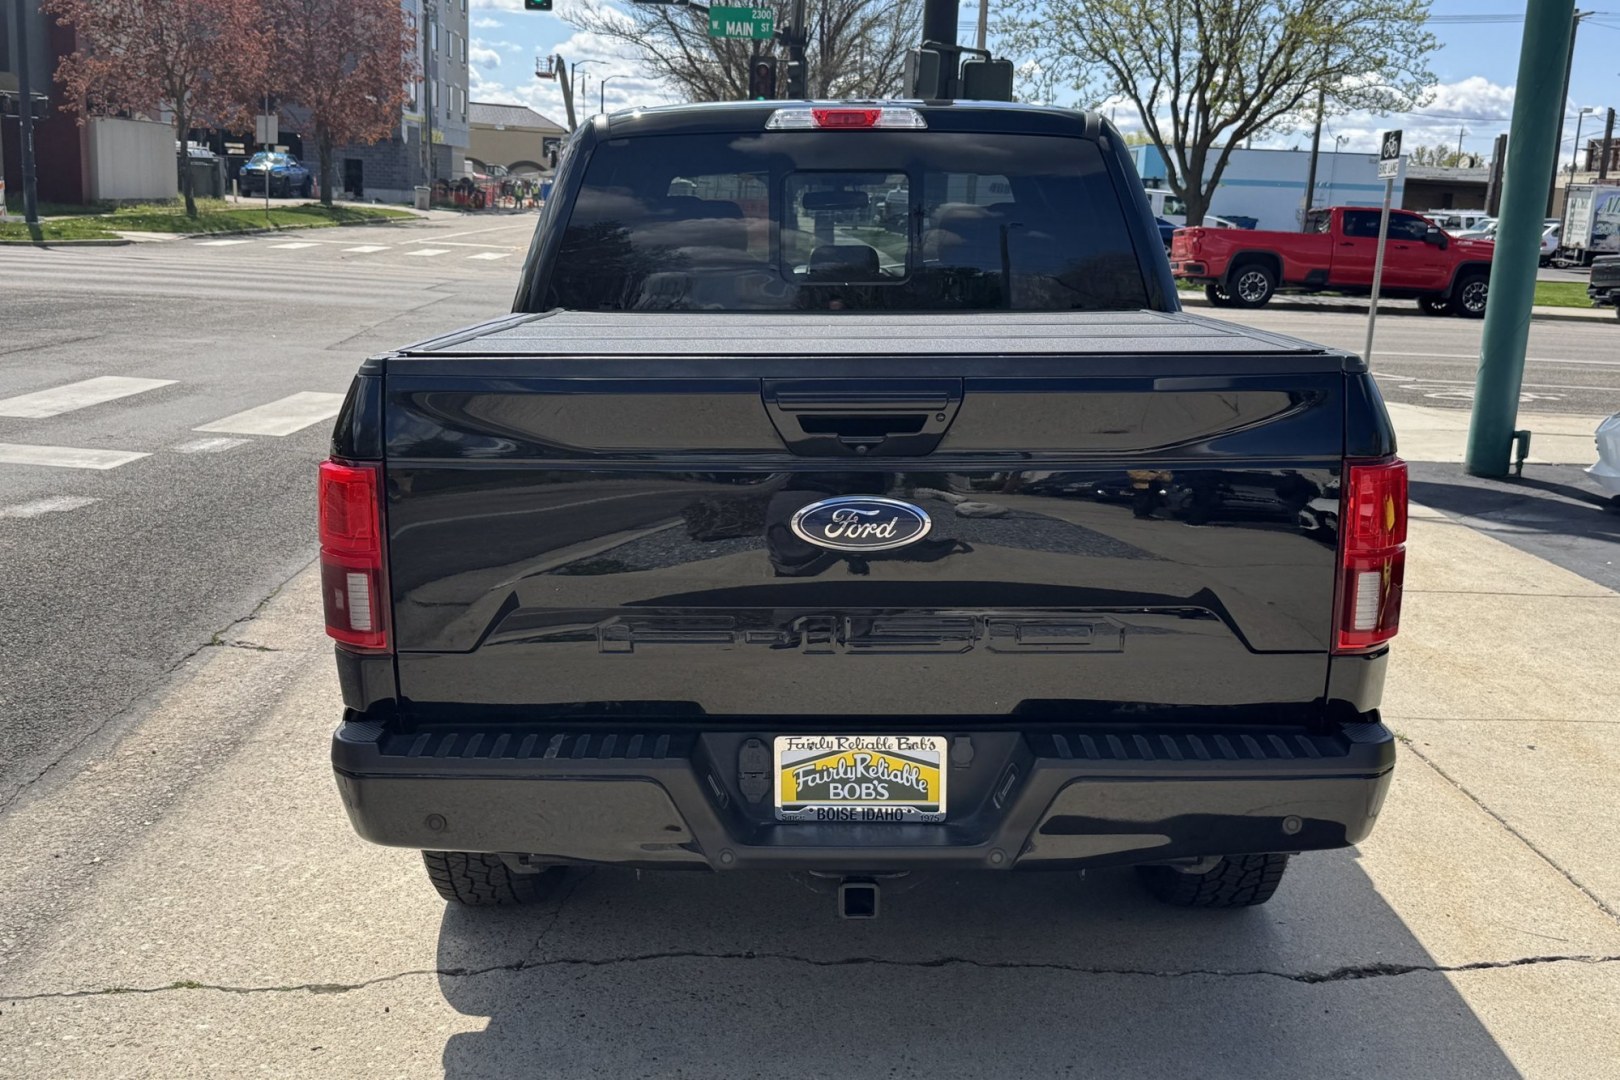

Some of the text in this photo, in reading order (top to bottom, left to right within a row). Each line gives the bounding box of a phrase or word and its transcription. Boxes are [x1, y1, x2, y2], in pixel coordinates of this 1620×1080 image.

[752, 9, 772, 20] 2300
[726, 20, 754, 36] MAIN
[761, 22, 770, 32] ST
[824, 508, 898, 538] Ford
[785, 736, 936, 751] Fairly Reliable Bob's
[829, 780, 890, 800] BOB'S
[817, 807, 904, 820] BOISE IDAHO
[920, 814, 940, 822] 1975
